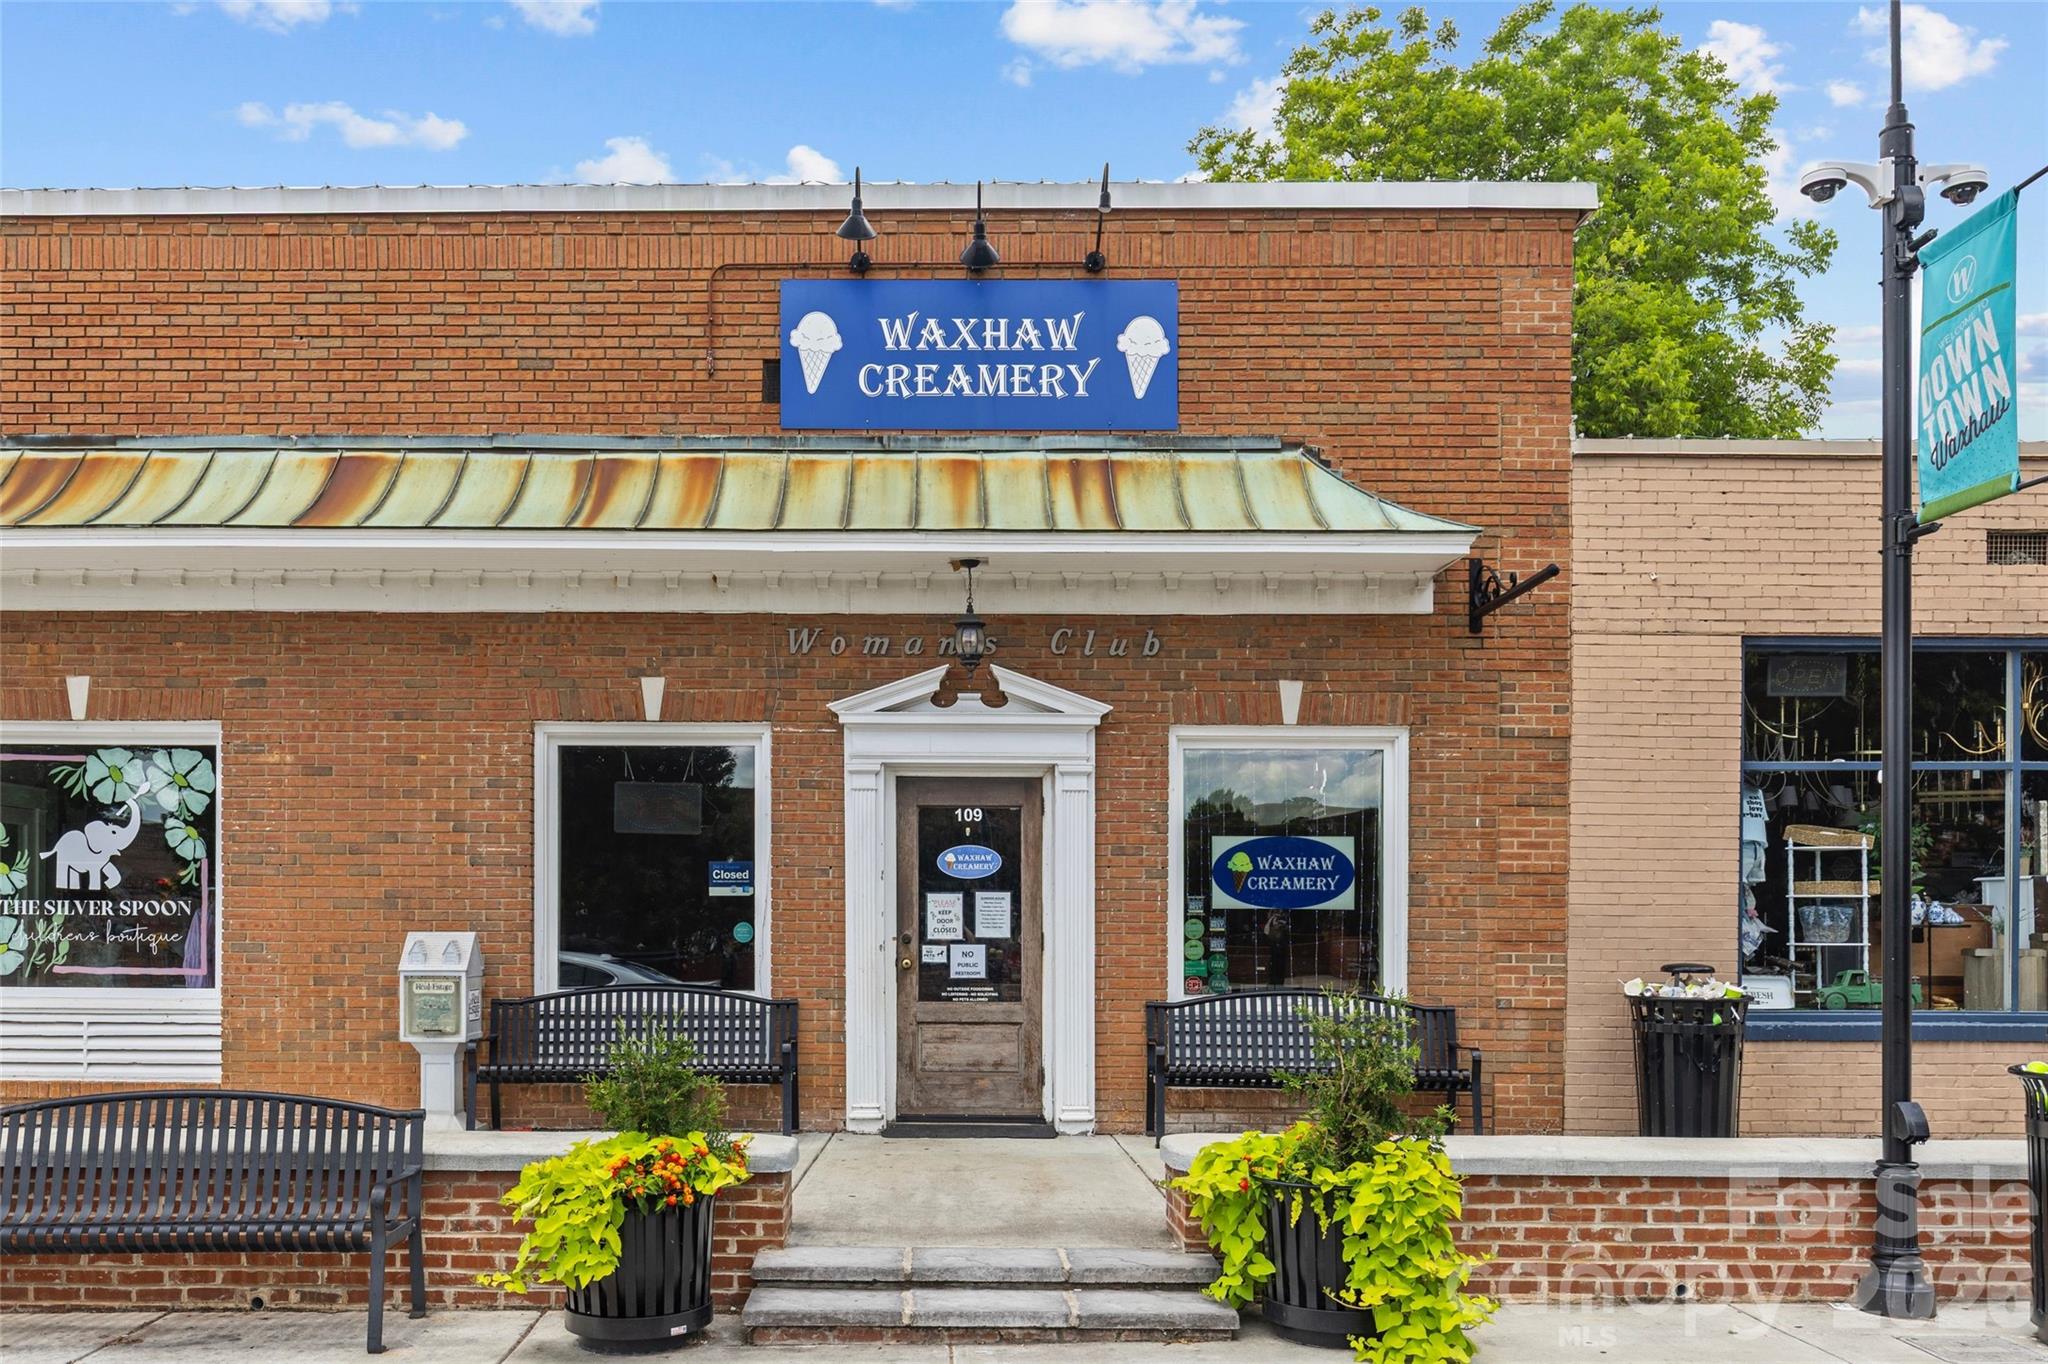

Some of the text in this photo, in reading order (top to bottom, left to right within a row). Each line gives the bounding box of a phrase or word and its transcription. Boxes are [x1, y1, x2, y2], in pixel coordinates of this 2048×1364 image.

[878, 310, 1086, 350] WAXHAW
[1937, 309, 1977, 350] WELCOME
[1921, 308, 2000, 418] DOWN
[858, 357, 1102, 399] CREAMERY
[1923, 354, 2012, 451] TOWN
[1931, 396, 2011, 471] Waxhaw
[1050, 627, 1162, 656] Club
[954, 808, 983, 822] 109
[953, 862, 994, 870] CREAMERY
[957, 853, 993, 862] WAXHAW
[1257, 854, 1336, 871] WAXHAW
[712, 869, 749, 880] Closed
[1247, 874, 1340, 891] CREAMERY
[0, 900, 193, 916] THE SILVER SPOON
[12, 919, 184, 956] childrens boutique
